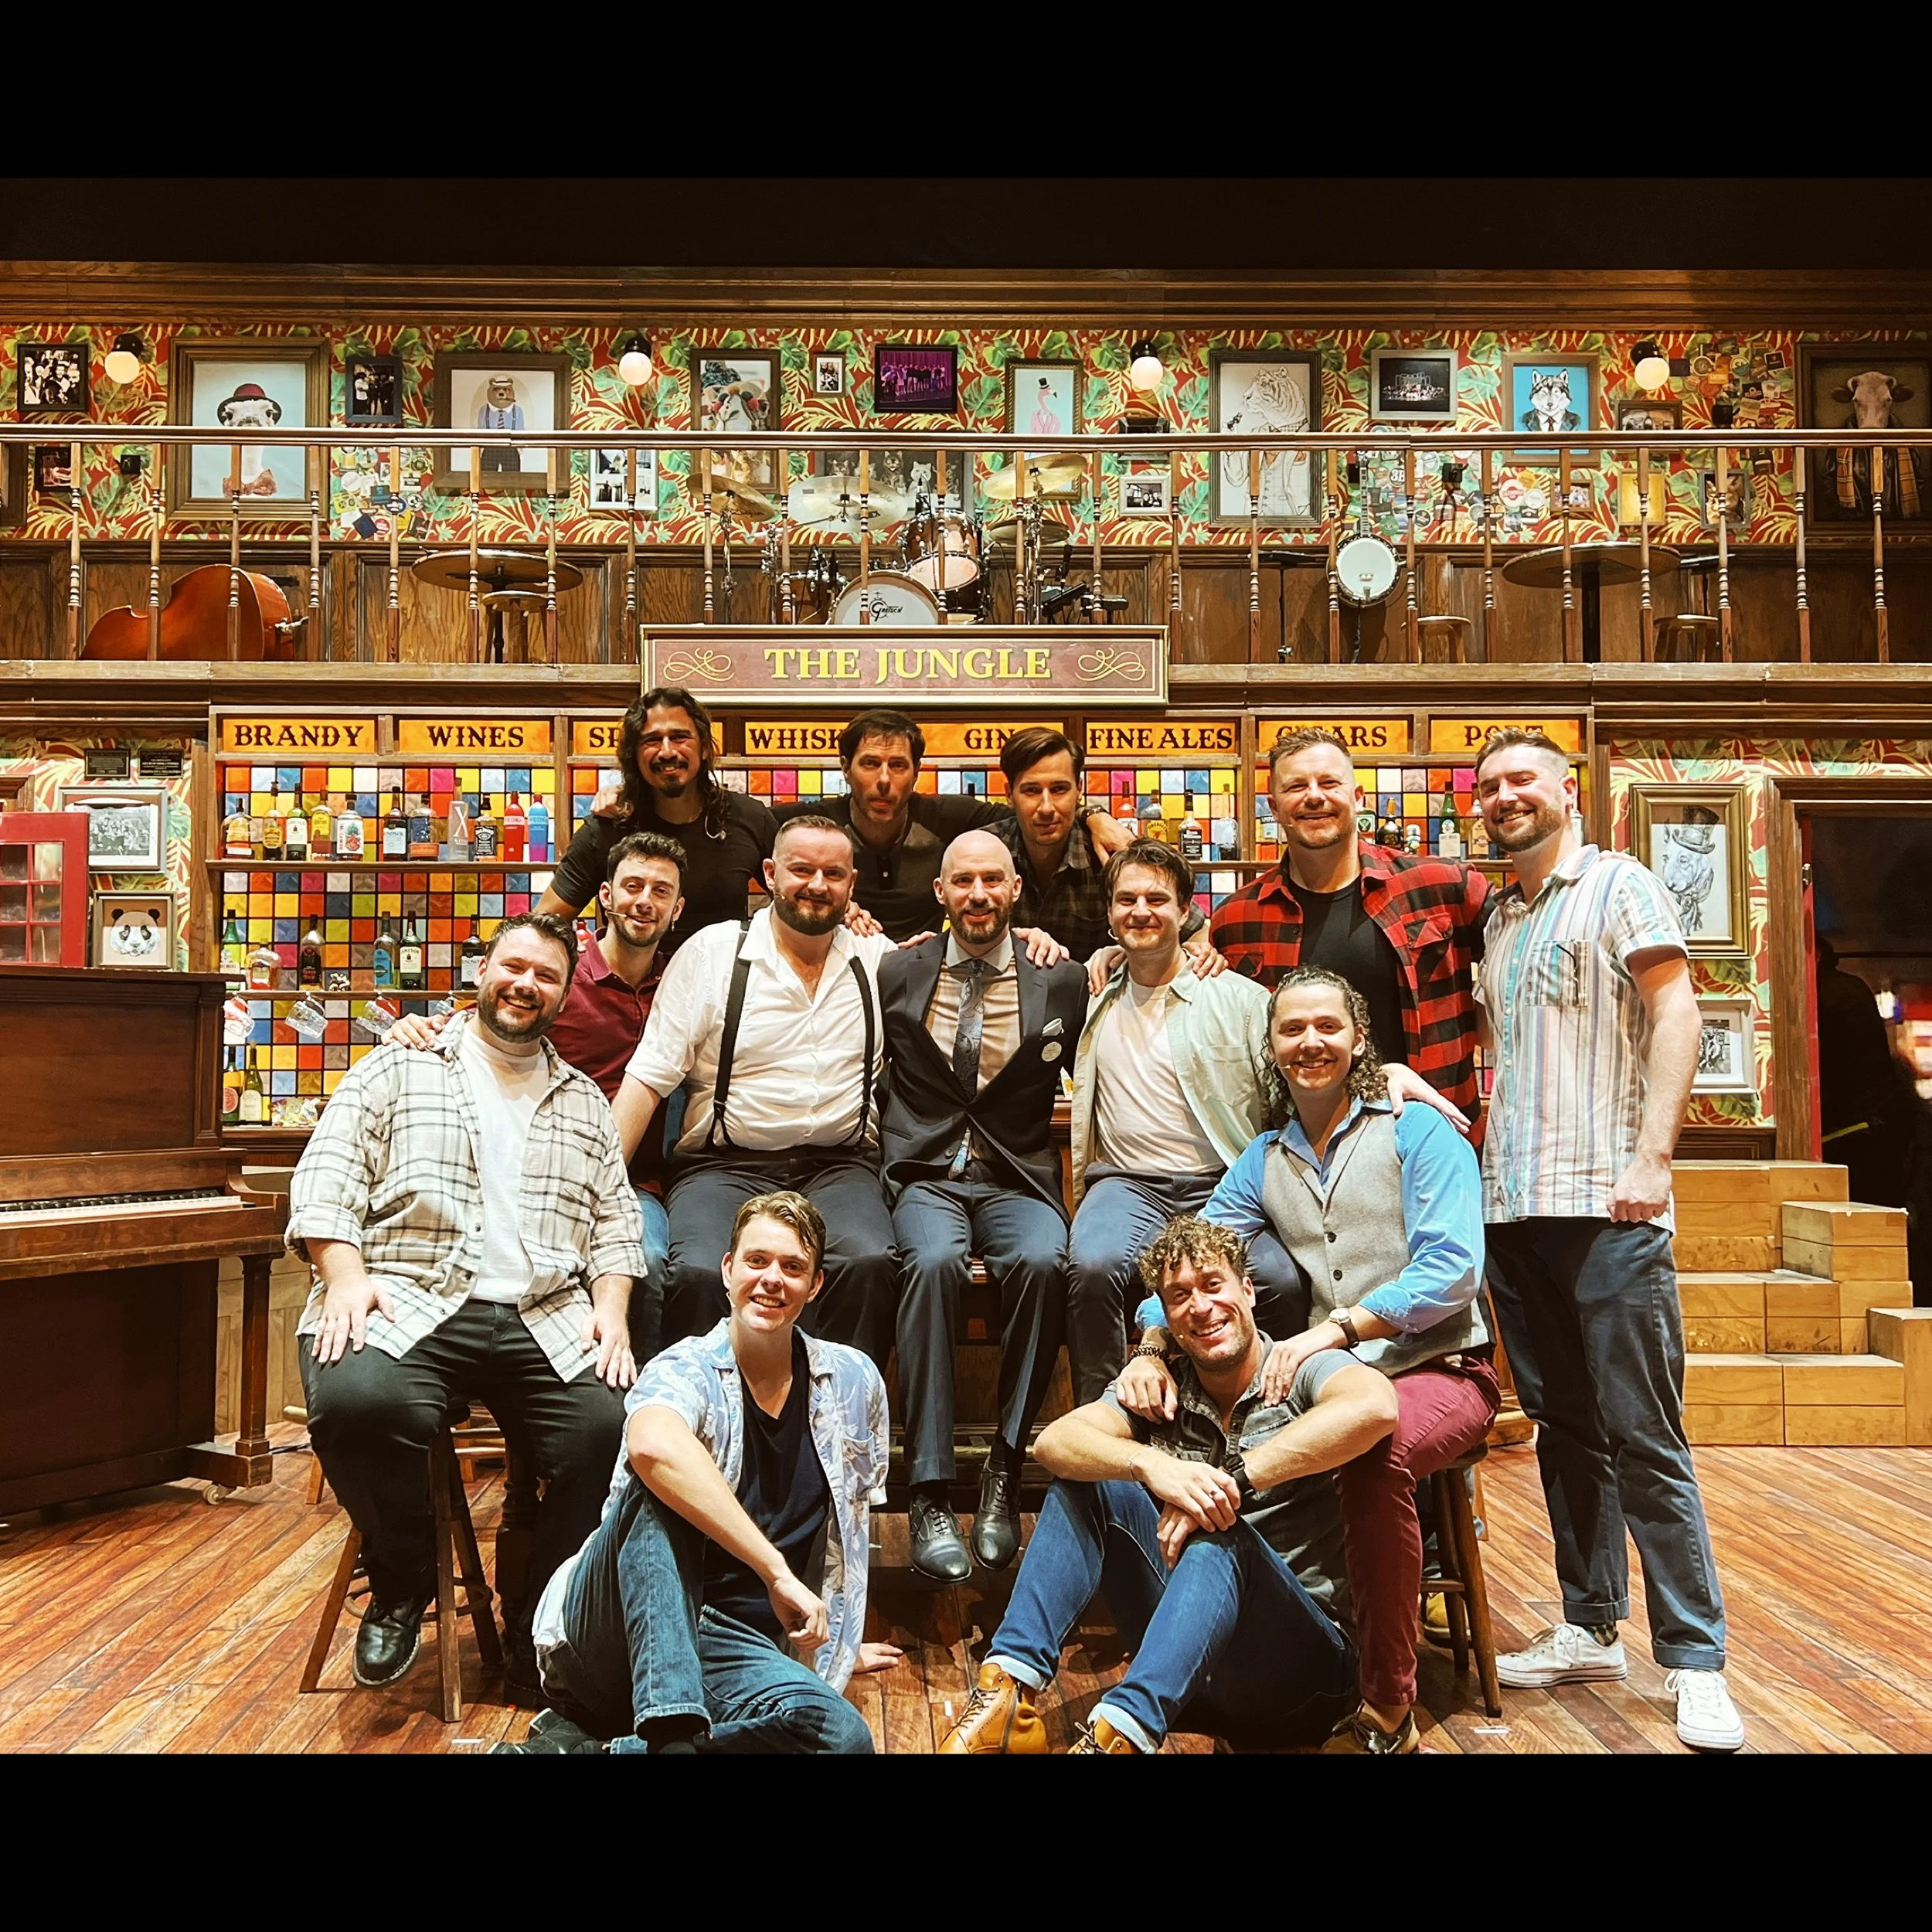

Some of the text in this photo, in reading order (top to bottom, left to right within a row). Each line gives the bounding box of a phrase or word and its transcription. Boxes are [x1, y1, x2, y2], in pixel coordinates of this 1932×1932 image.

[764, 648, 1052, 685] THE JUNGLE
[234, 724, 364, 747] BRANDY
[427, 726, 524, 748] WINES
[963, 729, 1015, 750] GIN
[1089, 728, 1233, 750] FINE ALES
